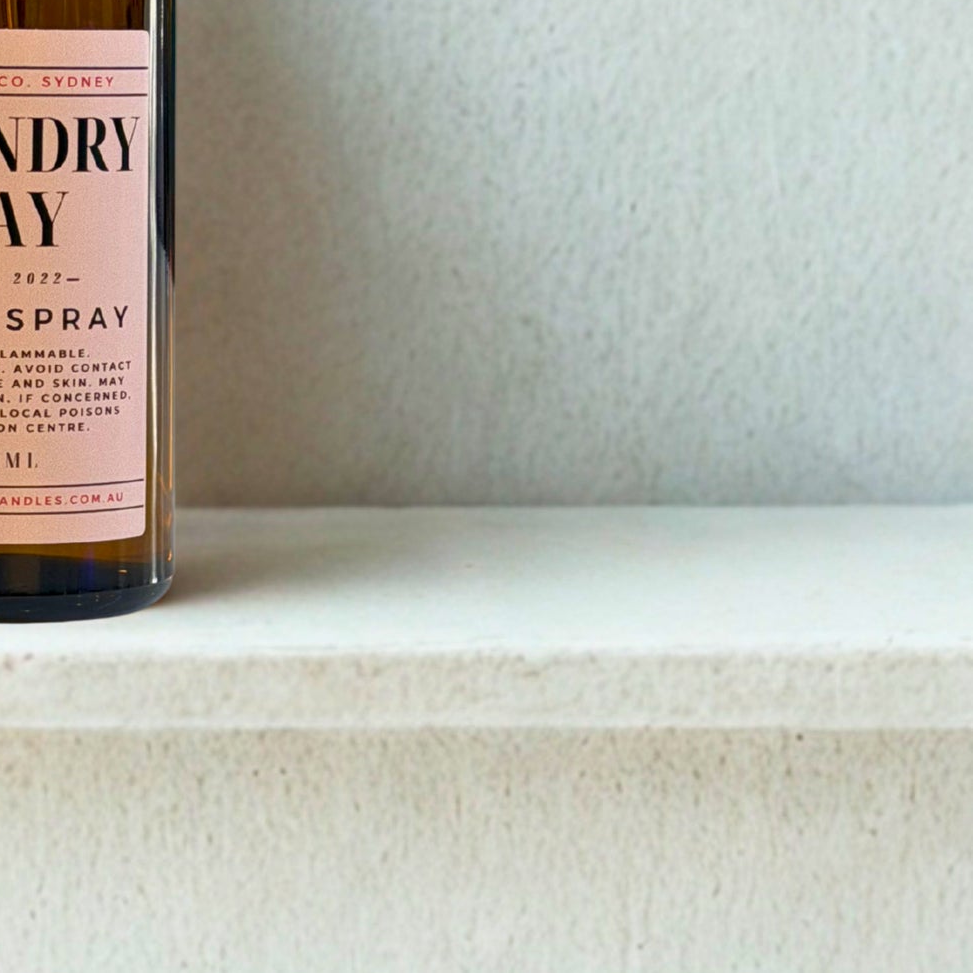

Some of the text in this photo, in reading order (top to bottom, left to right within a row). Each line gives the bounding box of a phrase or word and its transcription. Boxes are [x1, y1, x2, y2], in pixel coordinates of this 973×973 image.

[41, 76, 115, 88] SYDNEY
[6, 305, 129, 331] SPRAY
[14, 364, 64, 374] AVOID
[71, 360, 131, 373] CONTACT
[12, 379, 45, 389] AND
[99, 376, 124, 387] MAY
[19, 394, 34, 403] IF
[0, 408, 52, 418] LOCAL
[59, 406, 121, 417] POISONS
[26, 422, 90, 433] CENTRE.
